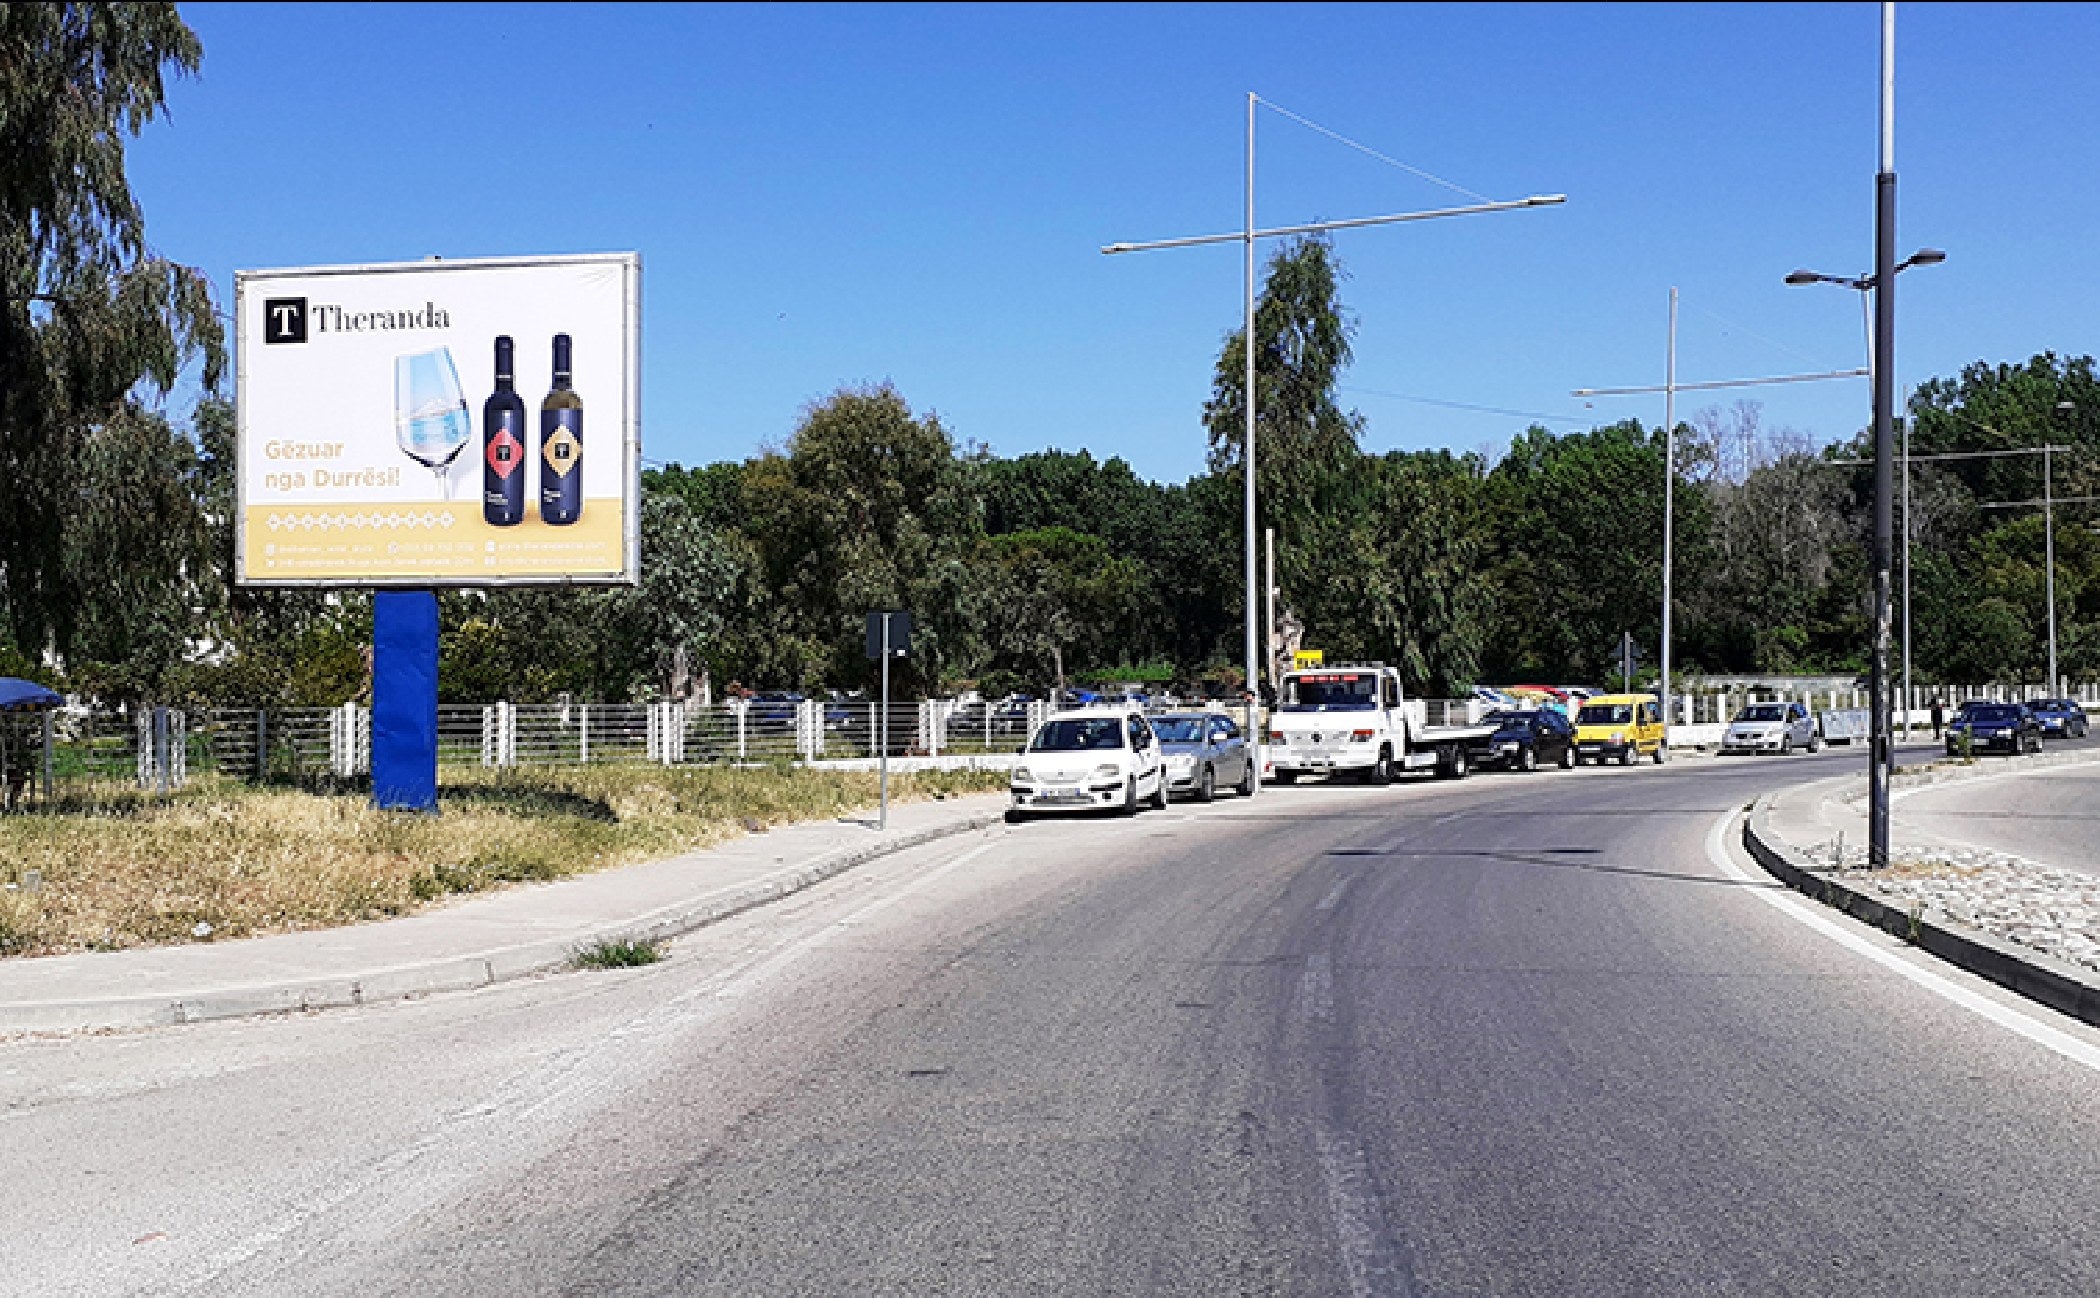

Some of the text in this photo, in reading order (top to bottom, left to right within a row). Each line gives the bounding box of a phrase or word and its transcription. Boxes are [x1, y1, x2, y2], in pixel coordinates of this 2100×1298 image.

[273, 302, 450, 336] T Theranda
[265, 472, 306, 491] nga
